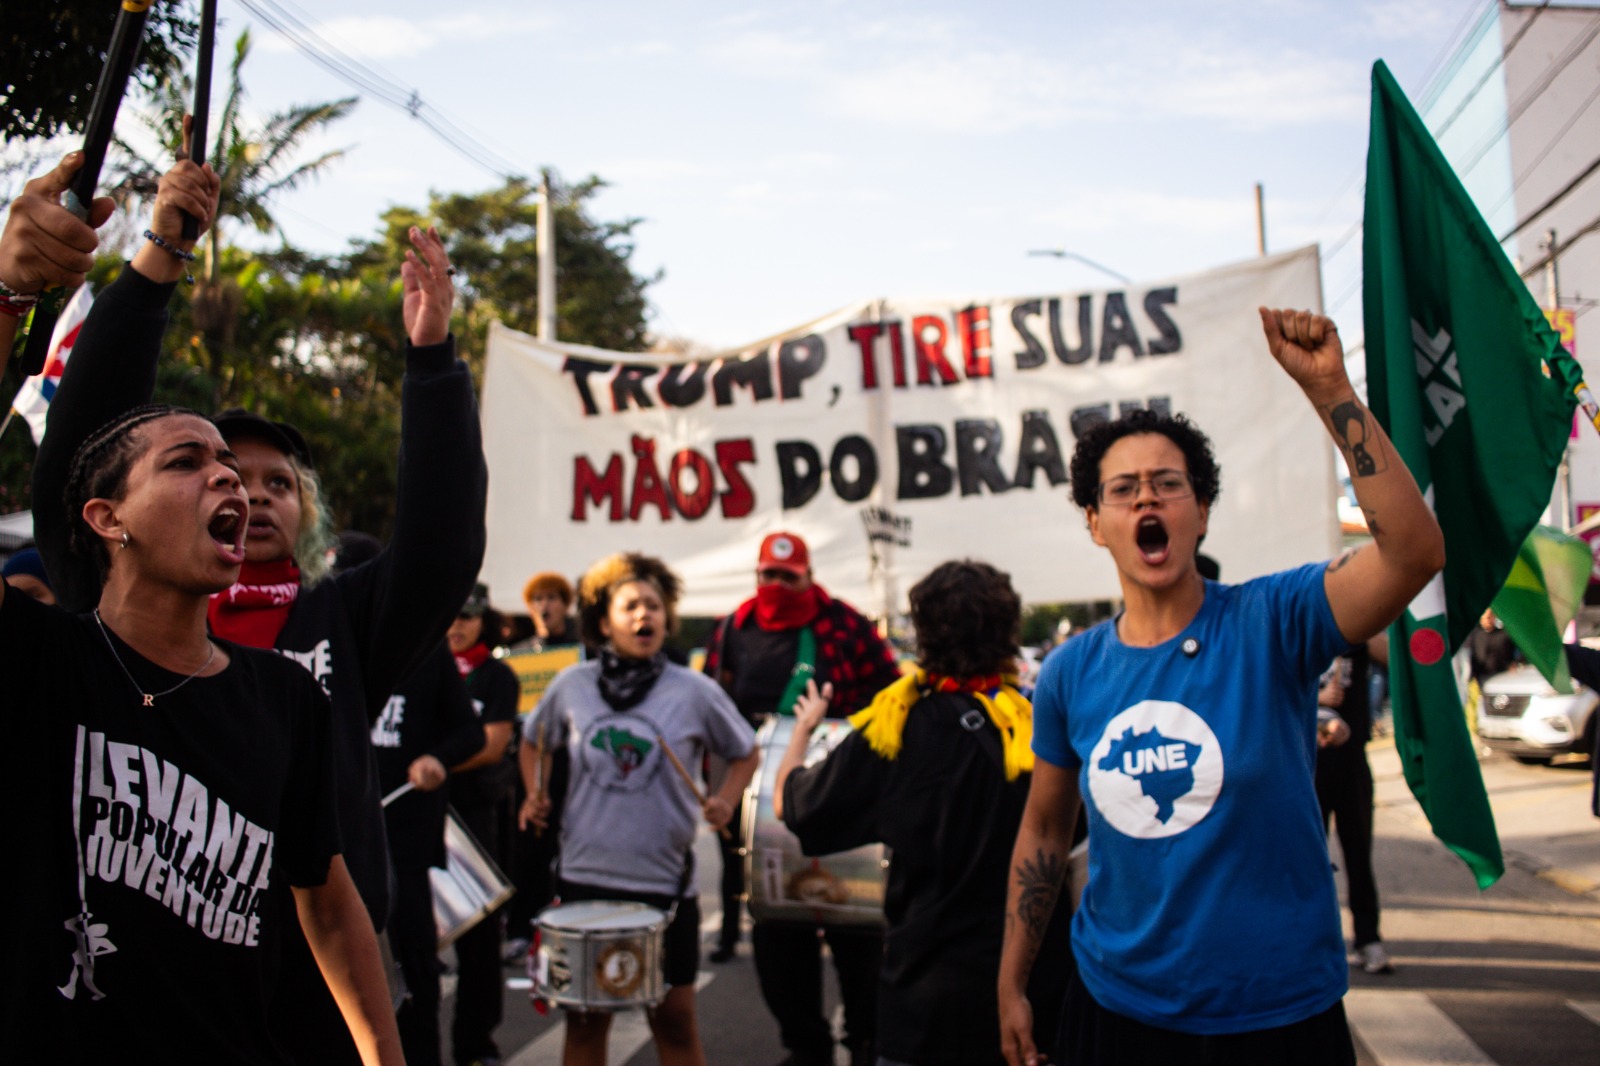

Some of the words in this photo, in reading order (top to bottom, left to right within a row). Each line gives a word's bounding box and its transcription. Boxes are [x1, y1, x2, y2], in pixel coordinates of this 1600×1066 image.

[562, 333, 841, 416] TRUMP,
[848, 305, 993, 390] TIRE
[1011, 286, 1182, 370] SUAS
[571, 434, 757, 521] MÃOS
[775, 434, 879, 510] DO
[896, 397, 1170, 500] BRA
[143, 694, 154, 706] R
[1123, 743, 1188, 776] UNE
[86, 834, 260, 947] JUVENTUDE
[88, 796, 229, 908] POPULAR
